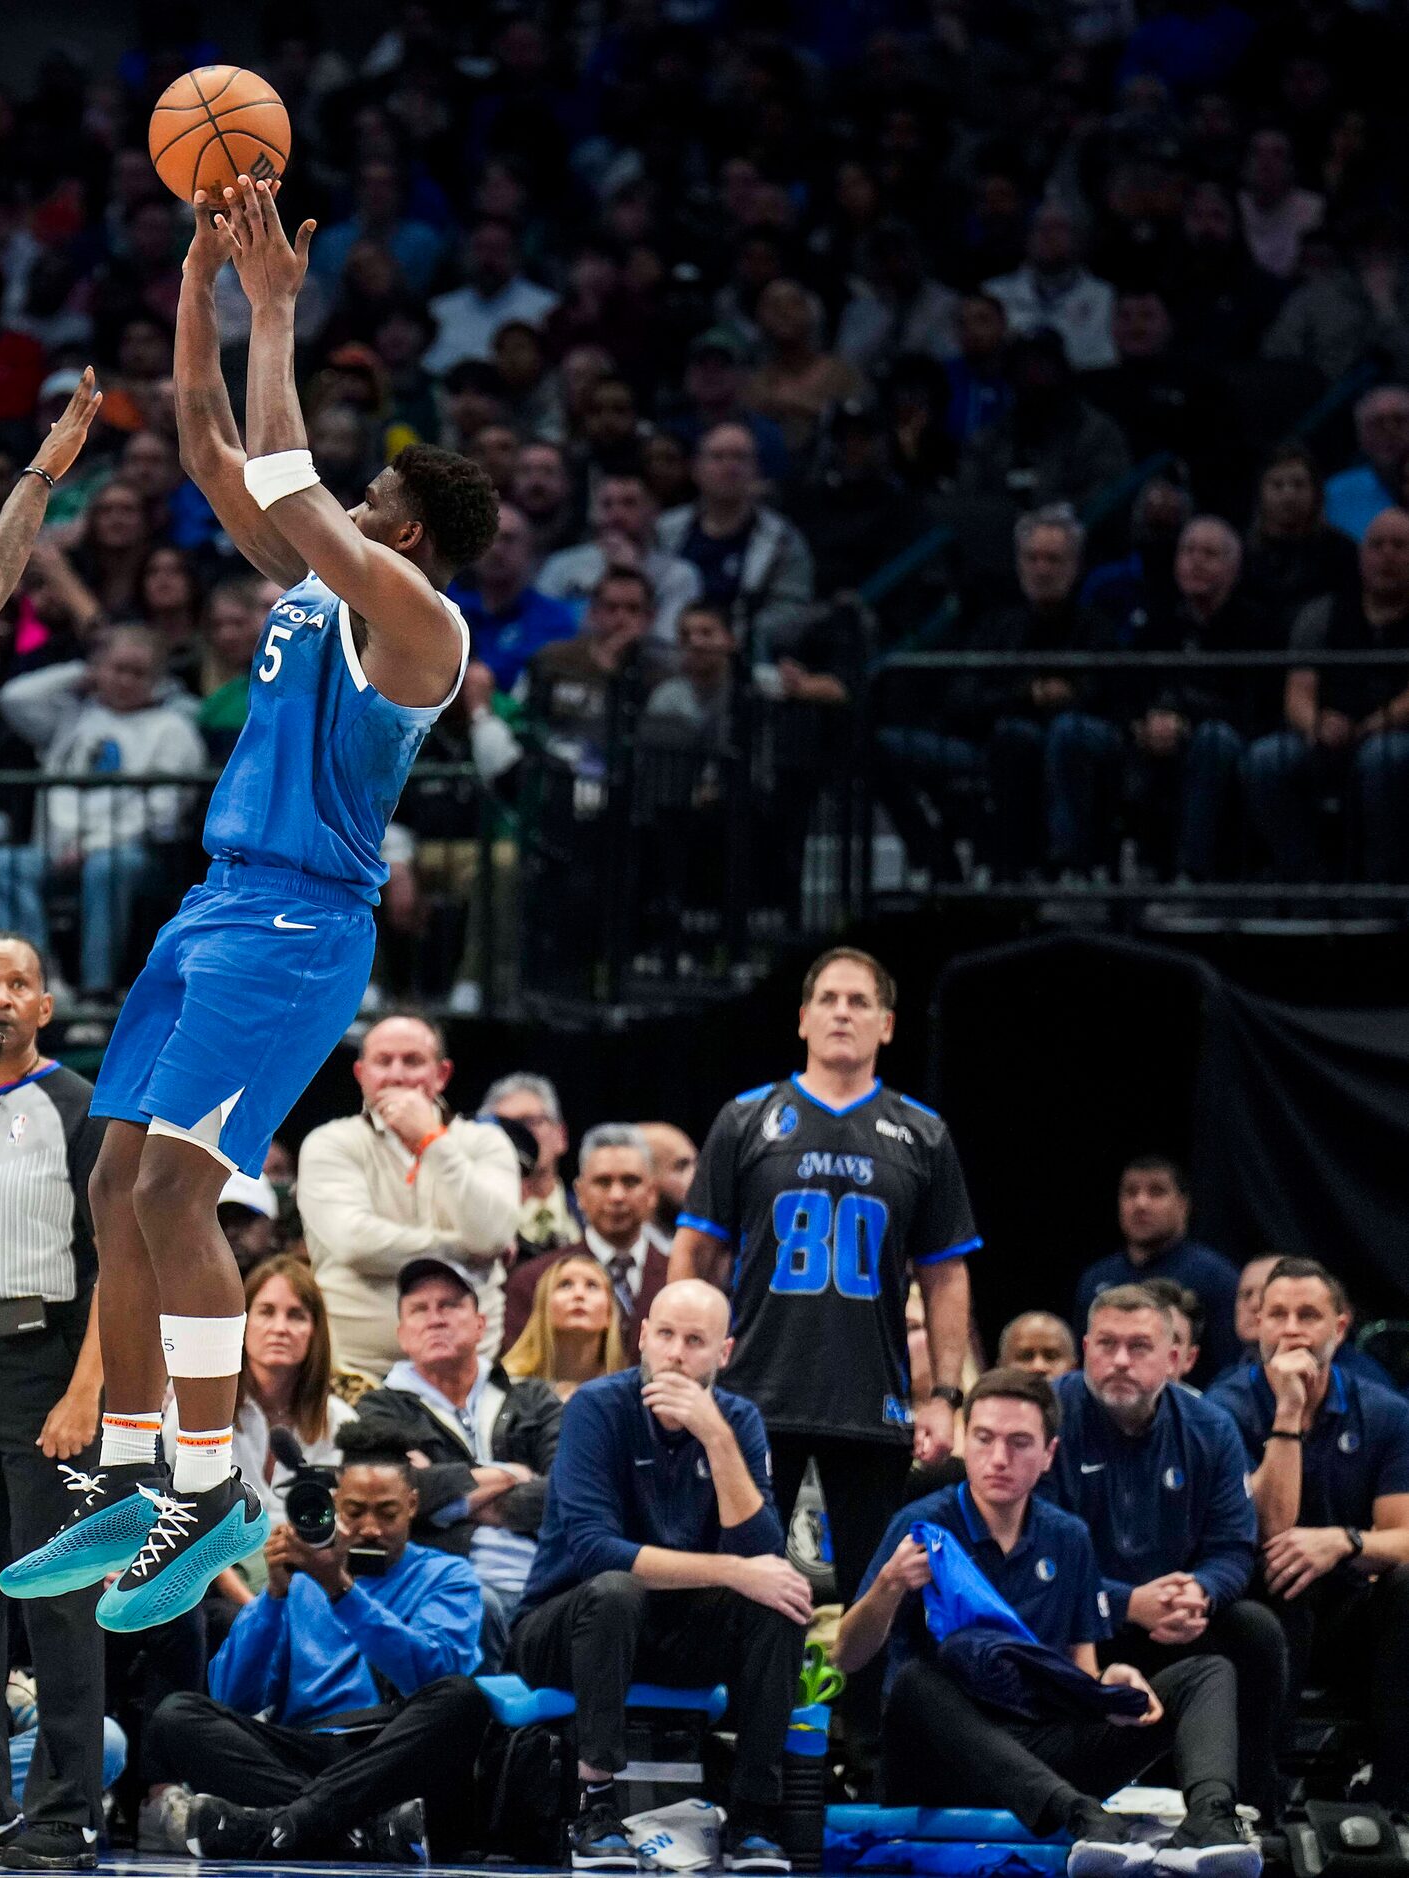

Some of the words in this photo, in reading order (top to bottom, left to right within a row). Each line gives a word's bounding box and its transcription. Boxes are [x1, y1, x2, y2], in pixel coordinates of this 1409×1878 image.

[258, 625, 293, 682] 5
[769, 1189, 889, 1300] 80
[164, 1338, 175, 1351] 5
